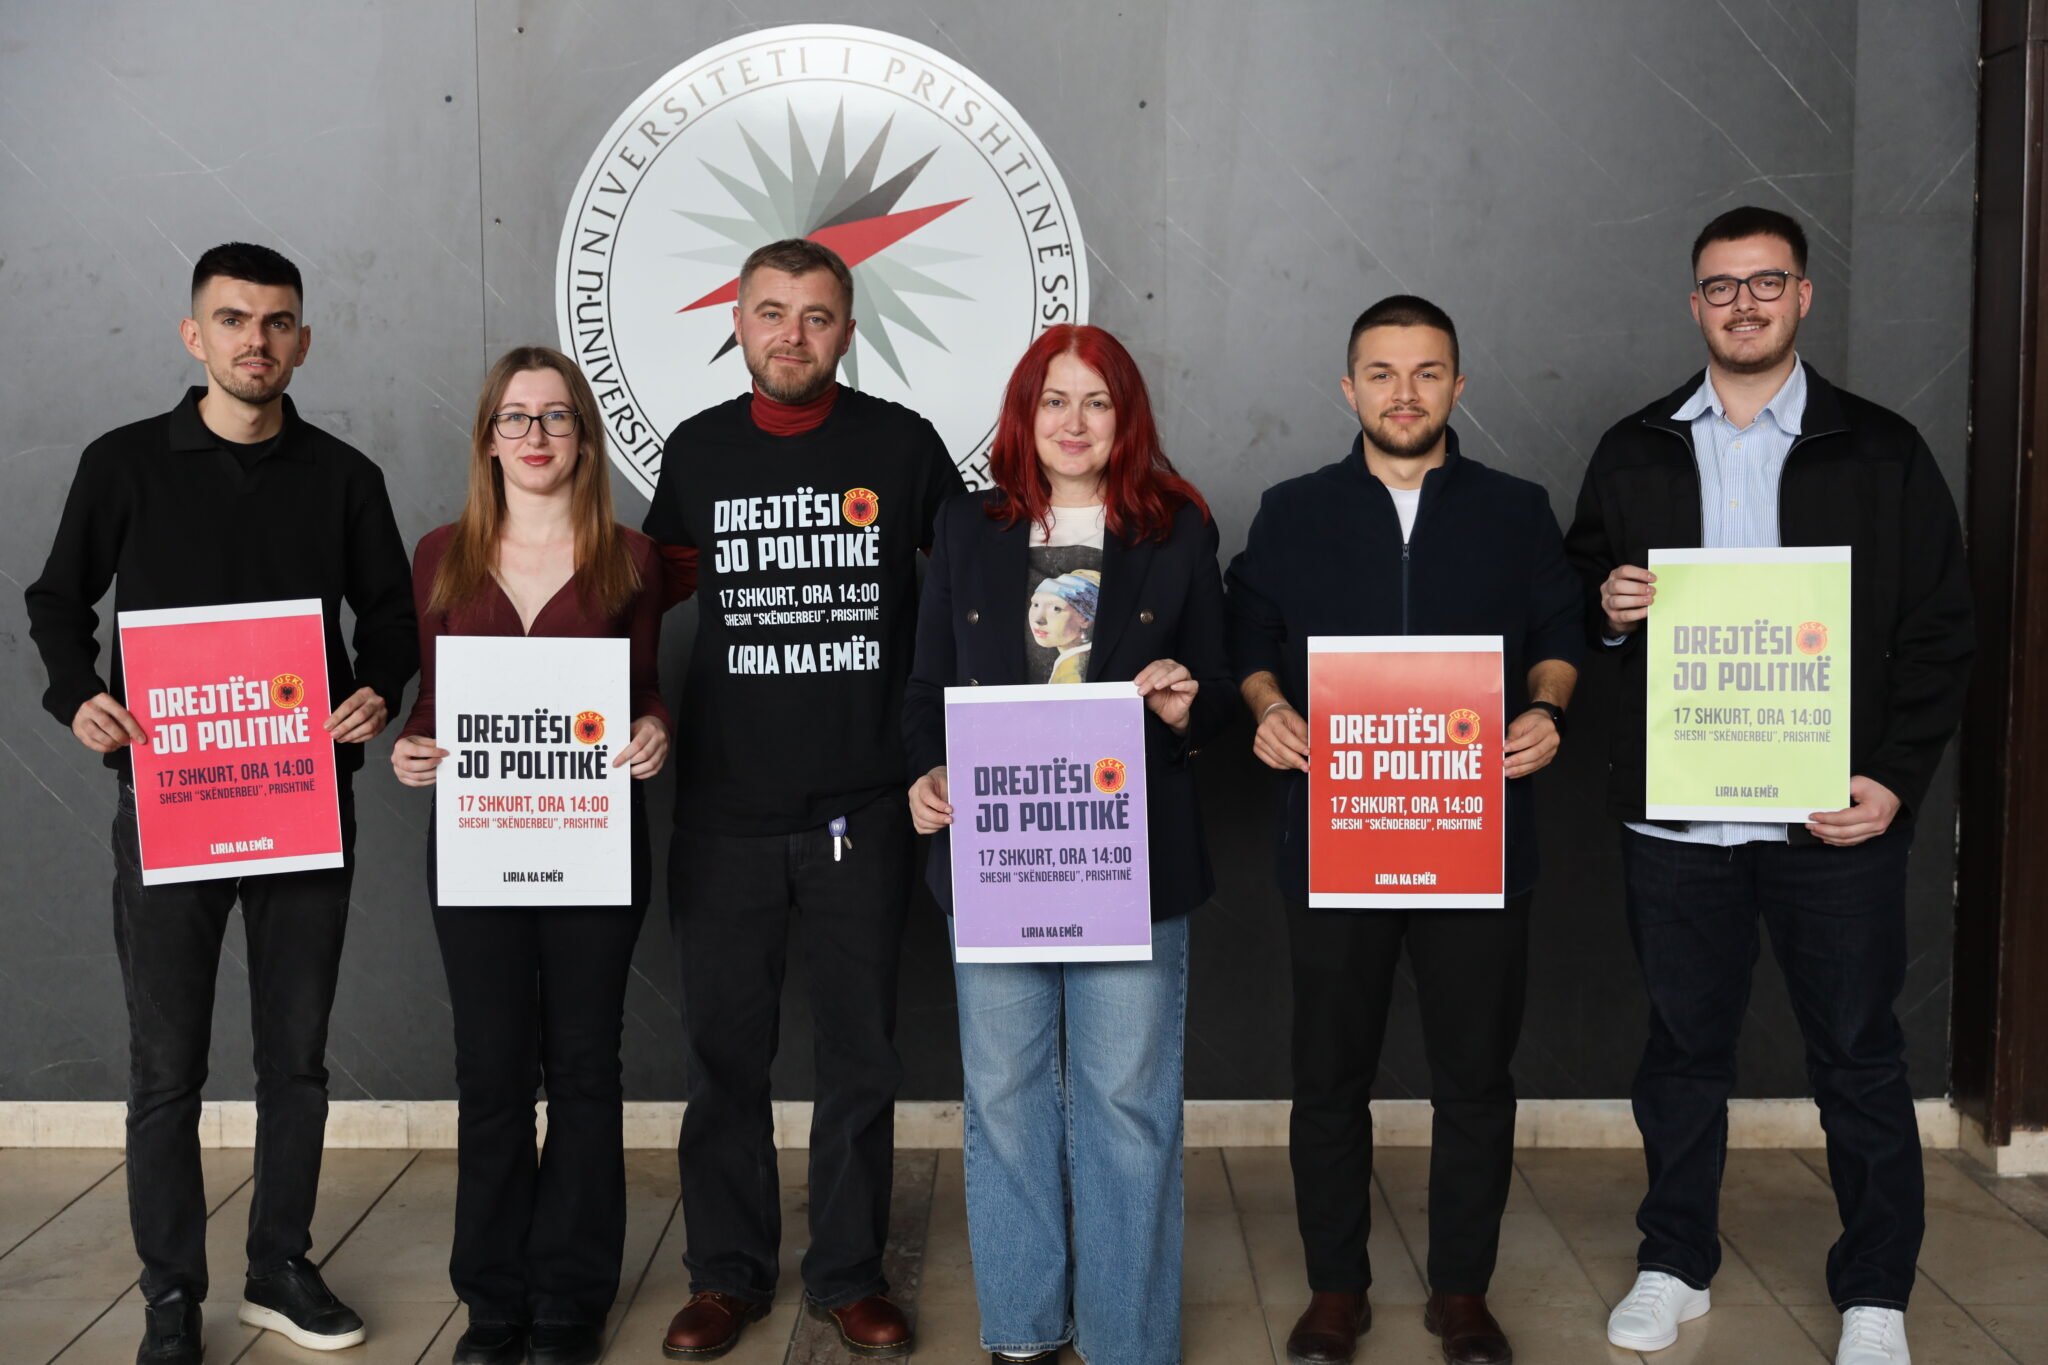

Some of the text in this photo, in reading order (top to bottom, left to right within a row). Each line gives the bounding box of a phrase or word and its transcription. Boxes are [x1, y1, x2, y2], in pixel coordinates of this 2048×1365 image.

[577, 46, 1070, 294] UNIVERSITETI I PRISHTINËS
[577, 301, 663, 476] UNIVERSIT
[714, 487, 840, 534] DREJTËSI
[715, 526, 880, 574] JO POLITIKË
[719, 583, 879, 608] 17 SHKURT, ORA 14:00
[724, 614, 752, 626] SHESHI
[832, 606, 879, 622] PRISHTINË
[1673, 619, 1792, 655] DREJTËSI
[728, 635, 880, 674] LIRIA KA EMËR
[1673, 656, 1832, 692] JO POLITIKË
[148, 675, 270, 719] DREJTËSI
[152, 706, 310, 755] JO POLITIKË
[457, 708, 572, 744] DREJTËSI
[1330, 707, 1446, 744] DREJTËSI
[1674, 708, 1832, 726] 17 SHKURT, ORA 14:00
[1674, 730, 1706, 742] SHESHI
[1783, 730, 1831, 742] PRISHTINË
[157, 758, 314, 788] 17 SHKURT, ORA 14:00
[458, 744, 608, 780] JO POLITIKË
[1330, 743, 1483, 780] JO POLITIKË
[974, 757, 1092, 796] DREJTËSI
[160, 792, 192, 805] SHESHI
[268, 778, 316, 795] PRISHTINË
[458, 796, 609, 814] 17 SHKURT, ORA 14:00
[1715, 784, 1778, 798] LIRIA KA EMËR
[976, 792, 1130, 832] JO POLITIKË
[1330, 796, 1483, 816] 17 SHKURT, ORA 14:00
[458, 818, 490, 828] SHESHI
[563, 816, 609, 829] PRISHTINË
[1331, 819, 1363, 830] SHESHI
[1436, 817, 1483, 830] PRISHTINË
[210, 836, 274, 855] LIRIA KA EMËR
[978, 846, 1132, 868] 17 SHKURT, ORA 14:00
[503, 869, 564, 882] LIRIA KA EMËR
[980, 872, 1011, 884] SHESHI
[1086, 867, 1132, 882] PRISHTINË
[1375, 872, 1436, 885] LIRIA KA EMËR
[1022, 924, 1083, 938] LIRIA KA EMËR
